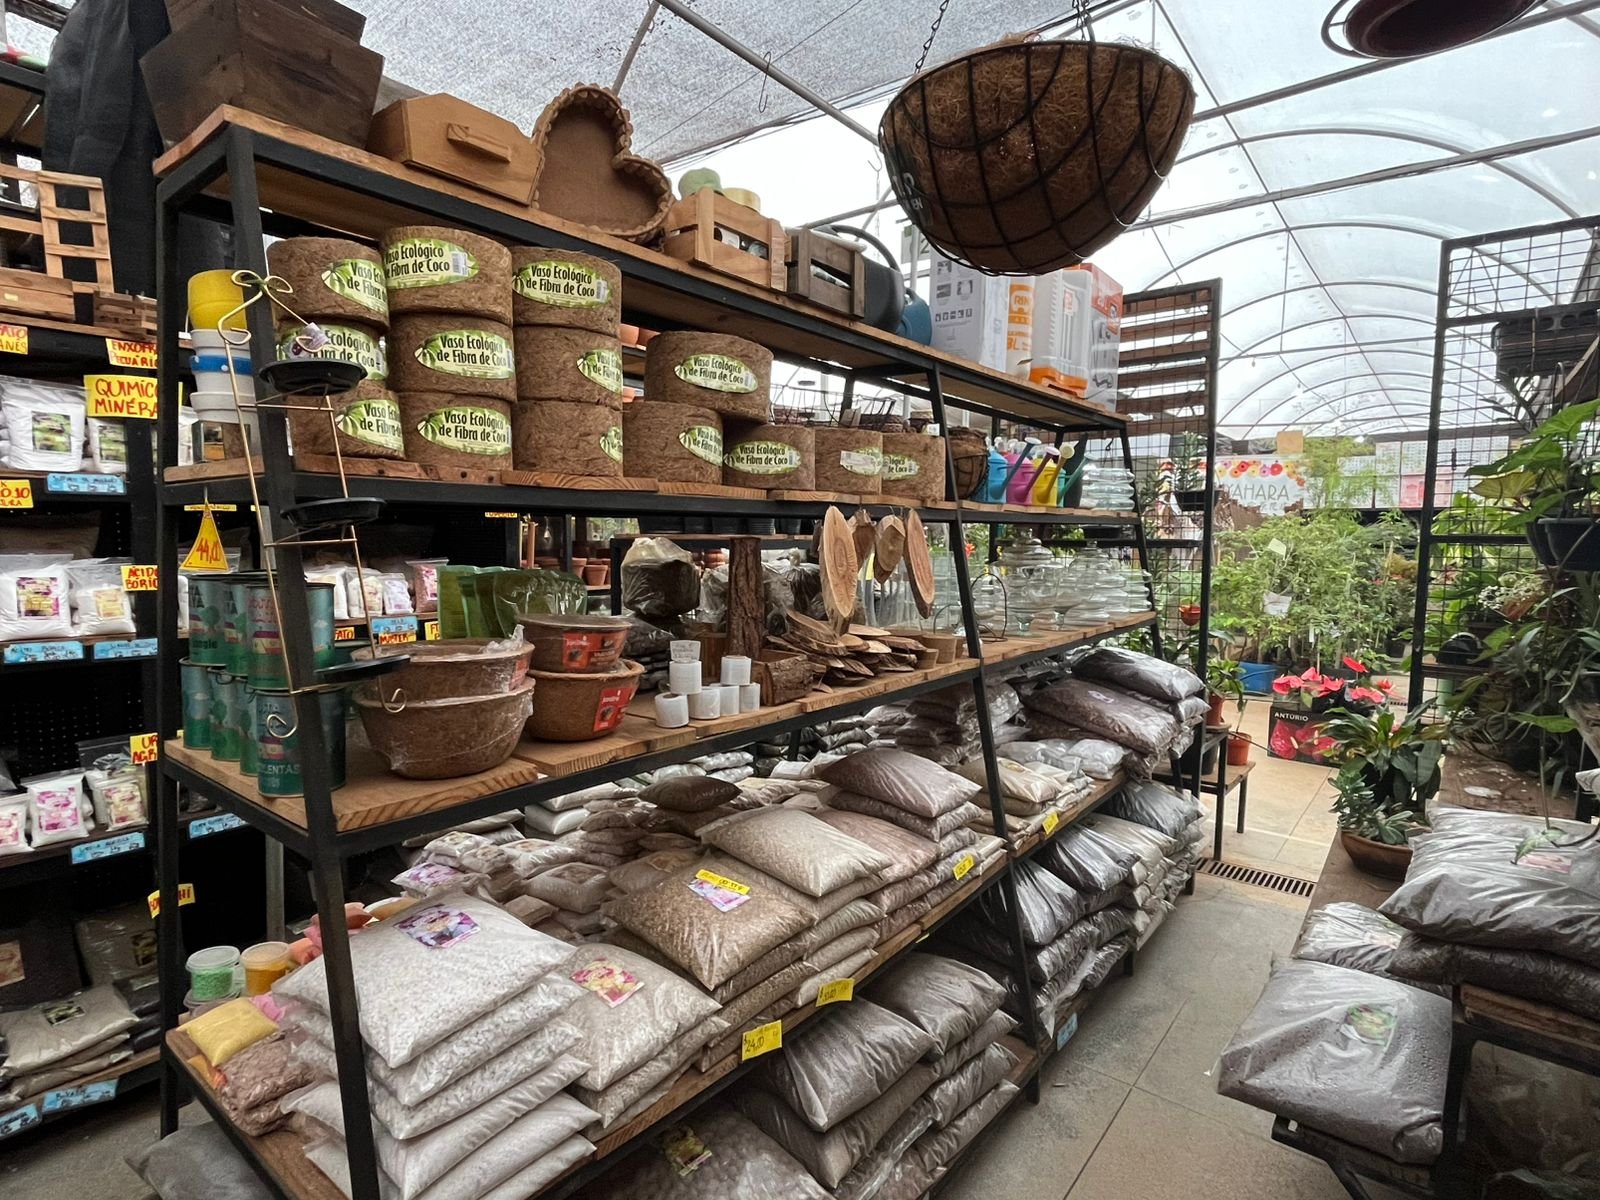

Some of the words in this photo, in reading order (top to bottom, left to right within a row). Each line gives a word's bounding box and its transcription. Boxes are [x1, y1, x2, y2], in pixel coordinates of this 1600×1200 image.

[401, 243, 444, 259] Ecológico
[350, 261, 373, 278] Vaso
[391, 261, 410, 278] Fibra
[411, 259, 424, 274] de
[426, 259, 450, 272] Coco
[531, 264, 552, 279] Vaso
[553, 265, 593, 285] Ecológico
[346, 276, 361, 292] de
[362, 279, 382, 300] Fibra
[526, 277, 538, 290] de
[539, 278, 562, 293] Fibra
[563, 281, 576, 296] de
[576, 283, 596, 298] Coco
[324, 329, 371, 353] Ecológico
[440, 334, 465, 349] Vaso
[466, 334, 504, 354] Ecológico
[355, 351, 375, 368] Coco
[436, 349, 450, 363] de
[452, 349, 477, 365] Fibra
[479, 351, 491, 366] de
[492, 352, 507, 367] Coco
[693, 356, 710, 368] Vaso
[711, 357, 743, 375] Ecológico
[688, 367, 699, 377] de
[699, 367, 718, 380] Fibra
[717, 370, 729, 382] de
[728, 372, 744, 385] Coco
[363, 403, 387, 419] Vaso
[443, 410, 468, 425] Vaso
[469, 411, 505, 430] Ecológico
[359, 417, 375, 432] de
[439, 424, 452, 438] de
[454, 425, 479, 441] Fibra
[480, 428, 491, 442] de
[492, 429, 506, 443] Coco
[739, 444, 755, 455] Vaso
[756, 444, 786, 456] Ecológico
[736, 455, 745, 465] de
[745, 454, 763, 465] Fibra
[763, 455, 773, 465] de
[773, 455, 788, 465] Coco
